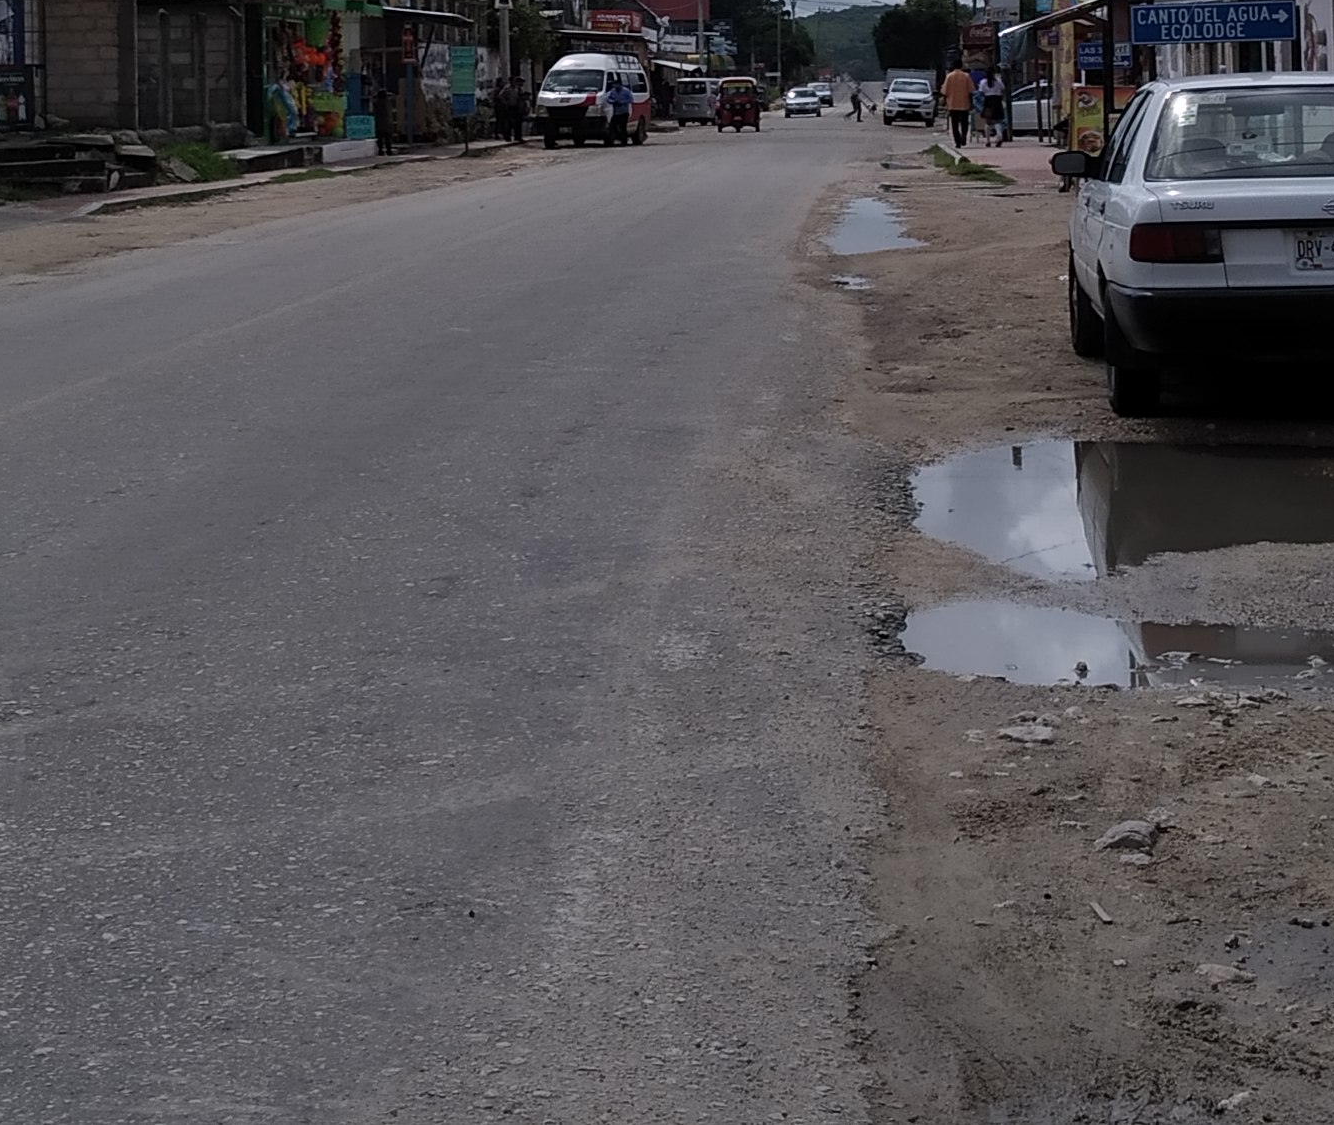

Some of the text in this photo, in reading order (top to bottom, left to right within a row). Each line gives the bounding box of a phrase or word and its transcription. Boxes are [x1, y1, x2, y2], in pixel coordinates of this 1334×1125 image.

[1137, 6, 1271, 25] CANTO DEL AGUA
[1161, 22, 1246, 40] ECOLODGE
[1170, 201, 1215, 210] TSURU
